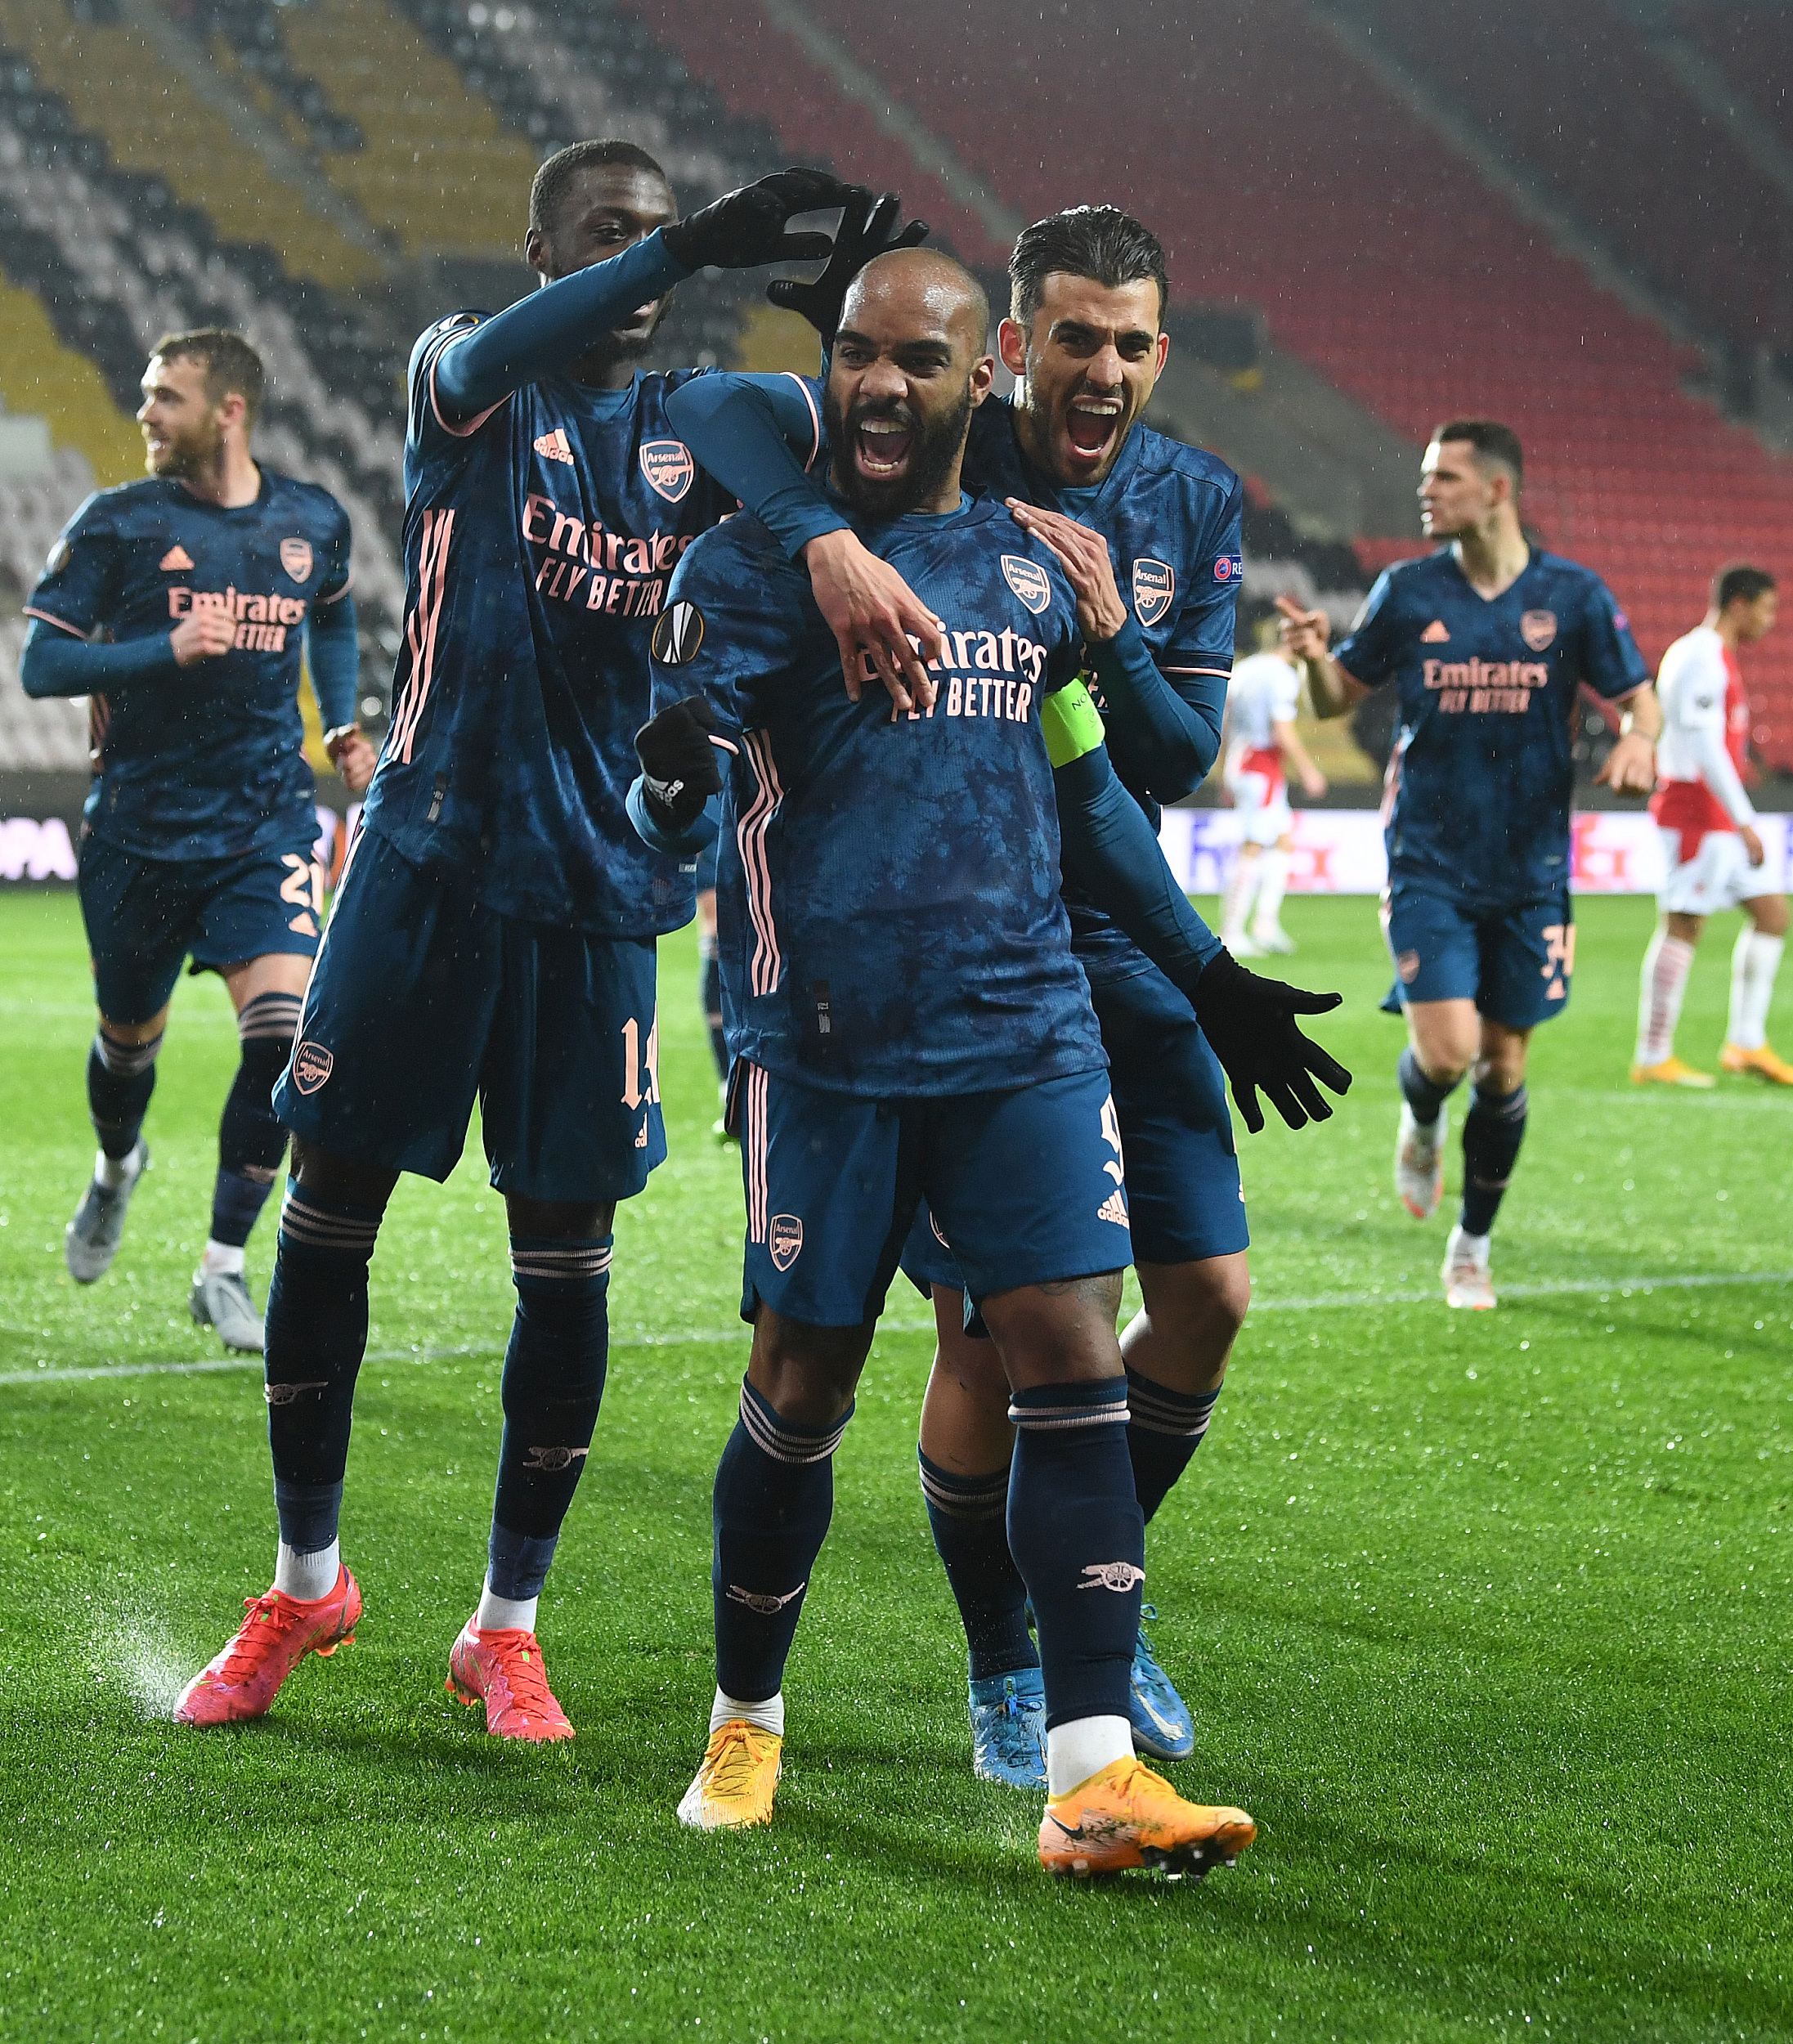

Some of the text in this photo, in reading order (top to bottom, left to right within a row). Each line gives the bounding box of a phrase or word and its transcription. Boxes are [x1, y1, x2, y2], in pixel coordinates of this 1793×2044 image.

[648, 452, 684, 464] Arsenal
[535, 558, 588, 603] FLY
[1009, 563, 1041, 582] Arsenal
[1135, 569, 1167, 585] Arsenal
[858, 621, 1048, 684] irates
[946, 677, 1032, 724] BETTER
[280, 853, 325, 917] 21
[1097, 1208, 1130, 1229] adida
